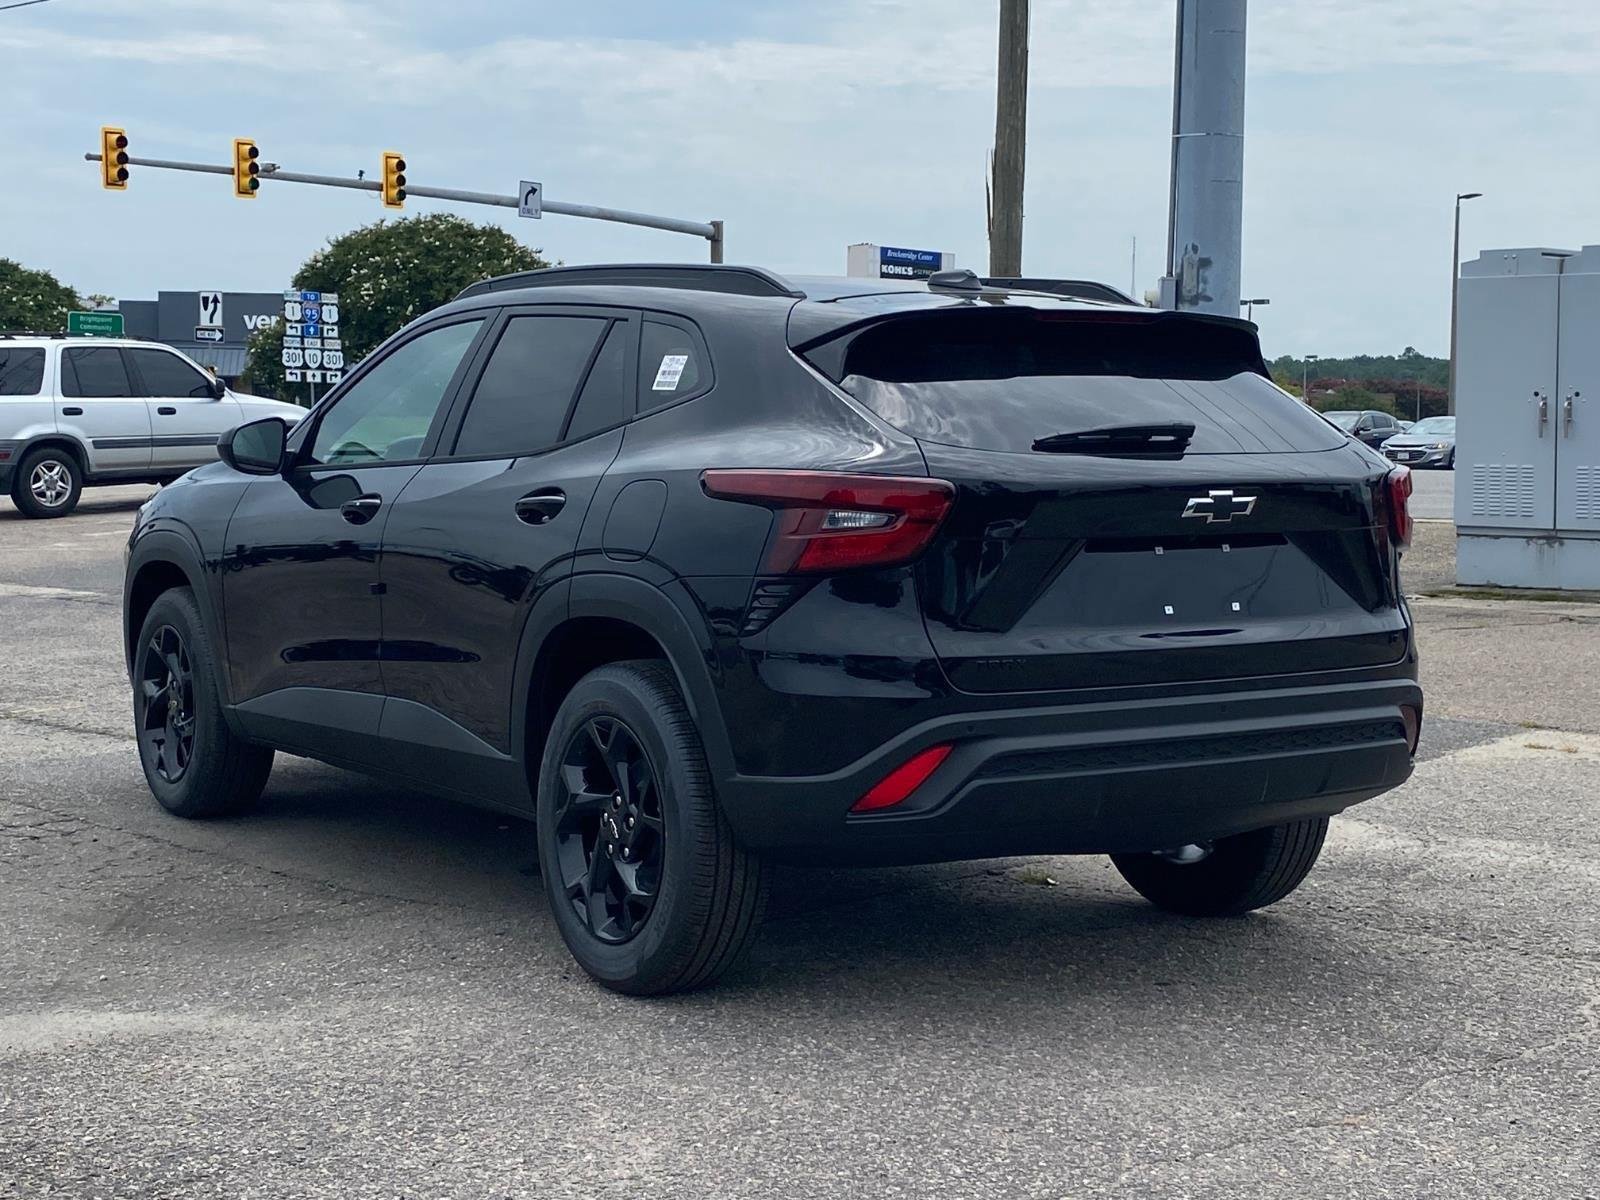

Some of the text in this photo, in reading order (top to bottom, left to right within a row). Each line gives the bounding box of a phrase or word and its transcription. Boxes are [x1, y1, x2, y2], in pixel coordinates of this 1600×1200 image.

[522, 207, 539, 216] ONLY
[305, 309, 318, 320] 95
[243, 314, 279, 330] ver
[285, 352, 301, 363] 301
[308, 353, 318, 364] 10
[326, 354, 341, 365] 301
